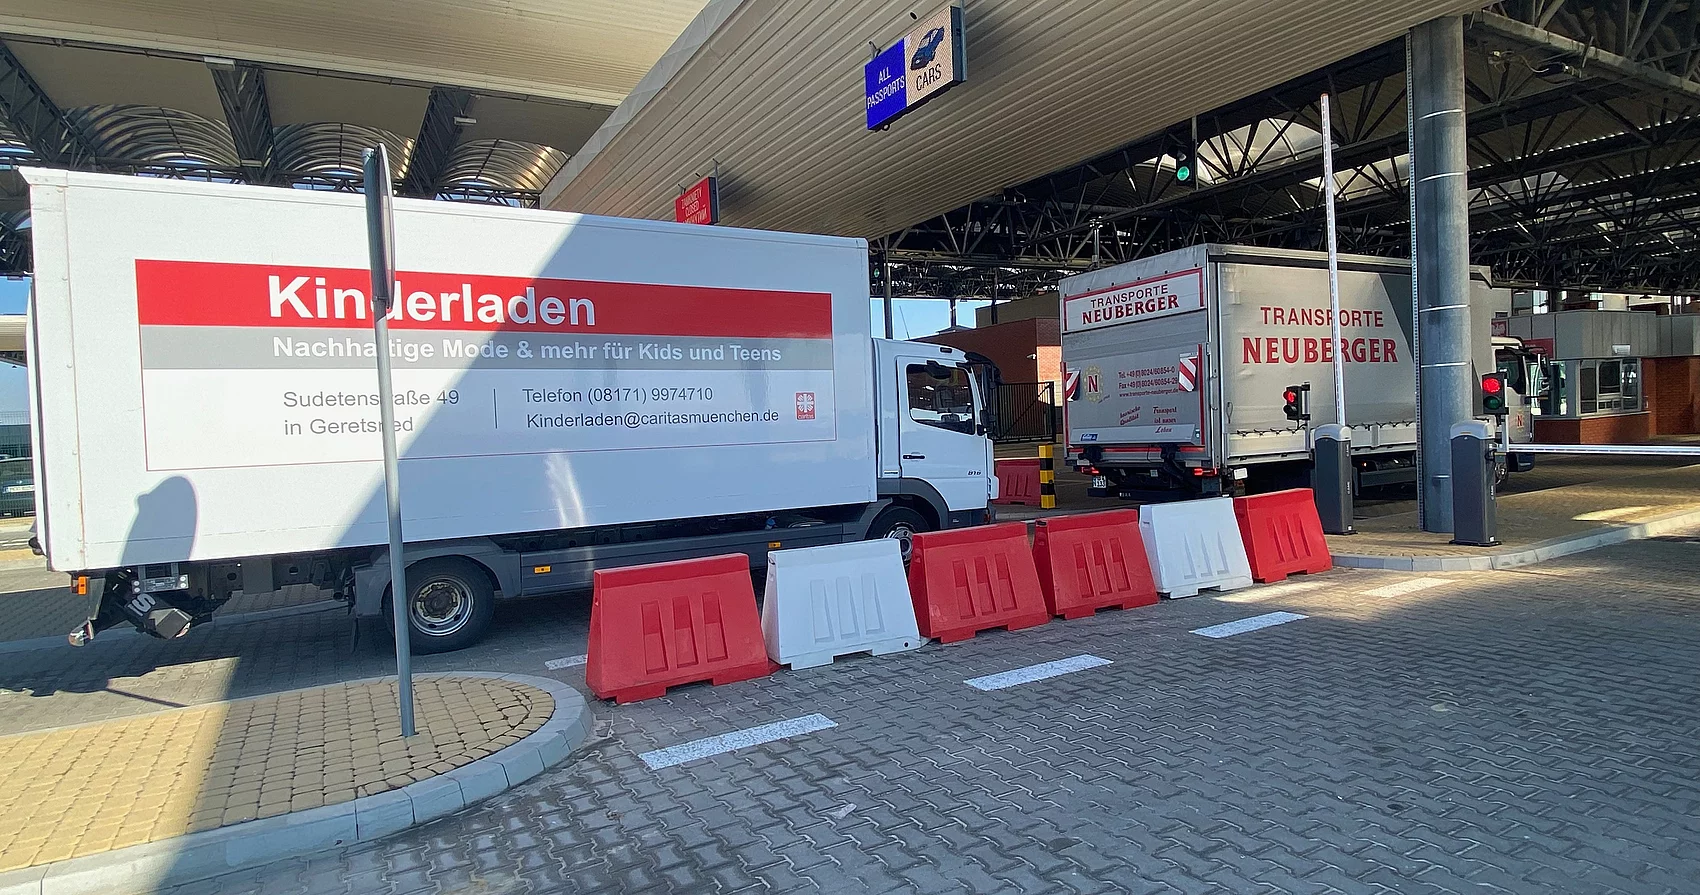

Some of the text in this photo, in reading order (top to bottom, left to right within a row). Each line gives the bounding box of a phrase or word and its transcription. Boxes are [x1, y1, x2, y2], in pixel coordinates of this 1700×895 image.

[879, 67, 891, 84] ALL
[916, 64, 941, 91] CARS
[867, 76, 904, 109] PASSPORTS
[268, 275, 596, 326] Kinderladen
[1091, 284, 1168, 308] TRANSPORTE
[1082, 295, 1179, 325] NEUBERGER
[1260, 307, 1383, 327] TRANSPORTE
[273, 336, 782, 363] Nachhatige Mode & mehr für Kids und Teens
[1242, 338, 1398, 363] NEUBERGER
[1088, 375, 1099, 392] N
[284, 389, 459, 408] Sudetensaße 49
[522, 388, 713, 405] Telefon (08171) 9974710
[527, 410, 779, 429] Kinderladen@caritasmuenchen.de
[1153, 406, 1177, 415] Transport
[284, 417, 413, 435] in Geretsred
